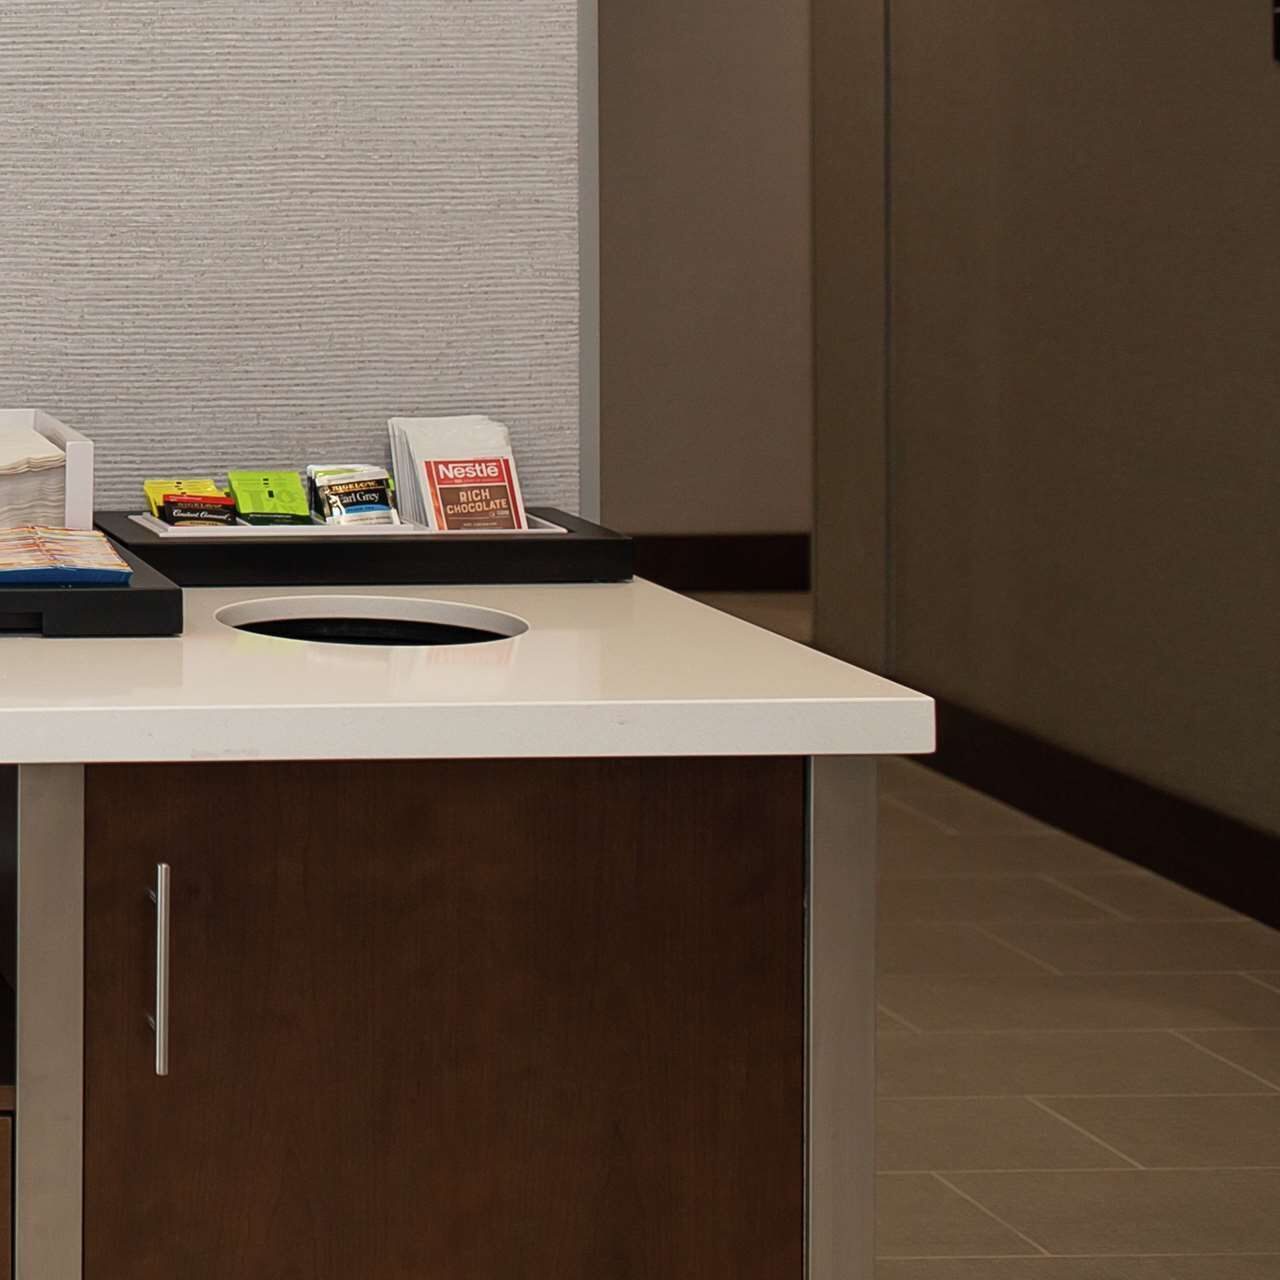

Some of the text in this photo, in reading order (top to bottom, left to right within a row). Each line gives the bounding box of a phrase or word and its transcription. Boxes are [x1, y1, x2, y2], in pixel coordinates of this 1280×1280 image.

[356, 491, 379, 502] Grey
[459, 488, 490, 502] RICH
[446, 499, 508, 514] CHOCOLATE
